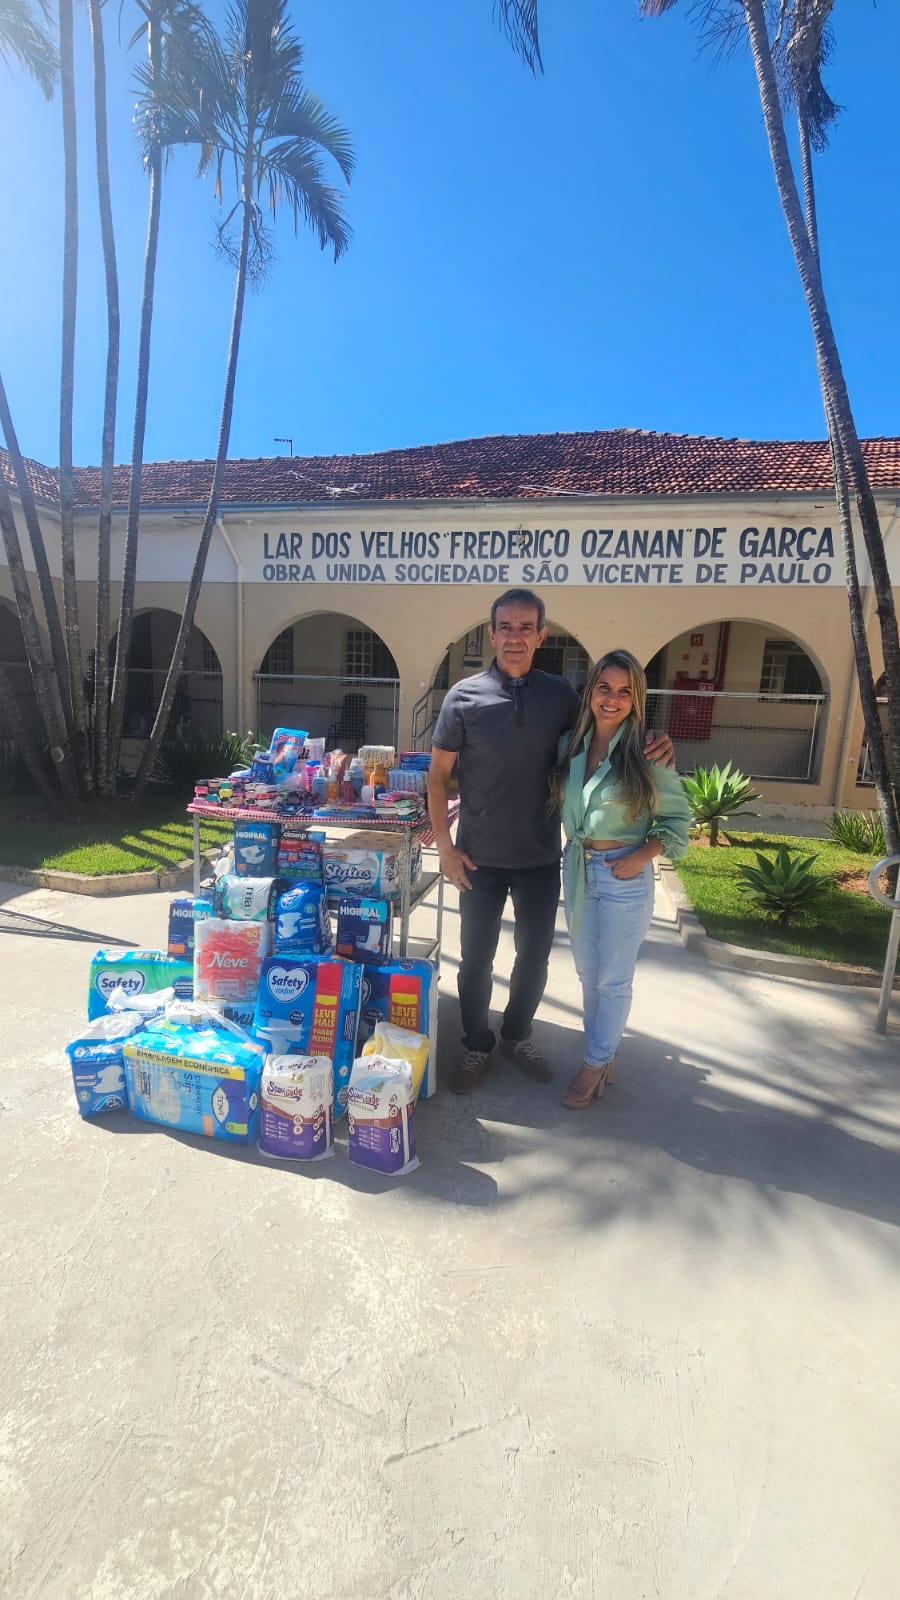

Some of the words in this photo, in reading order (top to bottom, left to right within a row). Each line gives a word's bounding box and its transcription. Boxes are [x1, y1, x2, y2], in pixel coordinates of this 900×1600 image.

[263, 532, 303, 560] LAR
[311, 531, 352, 559] DOS
[360, 530, 441, 559] VELHOS
[693, 527, 728, 558] DE
[739, 526, 835, 561] GARÇA
[262, 563, 316, 582] OBRA
[326, 563, 386, 582] UNIDA
[395, 563, 510, 583] SOCIEDADE
[521, 560, 569, 583] SÃO
[582, 563, 684, 584] VICENTE
[695, 563, 728, 584] DE
[740, 562, 832, 584] PAULO
[235, 831, 267, 840] HIGIFRAL
[324, 862, 372, 882] Stylus
[340, 906, 380, 918] HIGIFRAL
[207, 950, 249, 969] Neve
[101, 977, 141, 991] Safety
[271, 975, 304, 990] Safety
[315, 1008, 337, 1019] LEVE
[391, 1005, 417, 1018] LEVE
[313, 1017, 335, 1028] MAIS
[391, 1015, 417, 1028] MAIS
